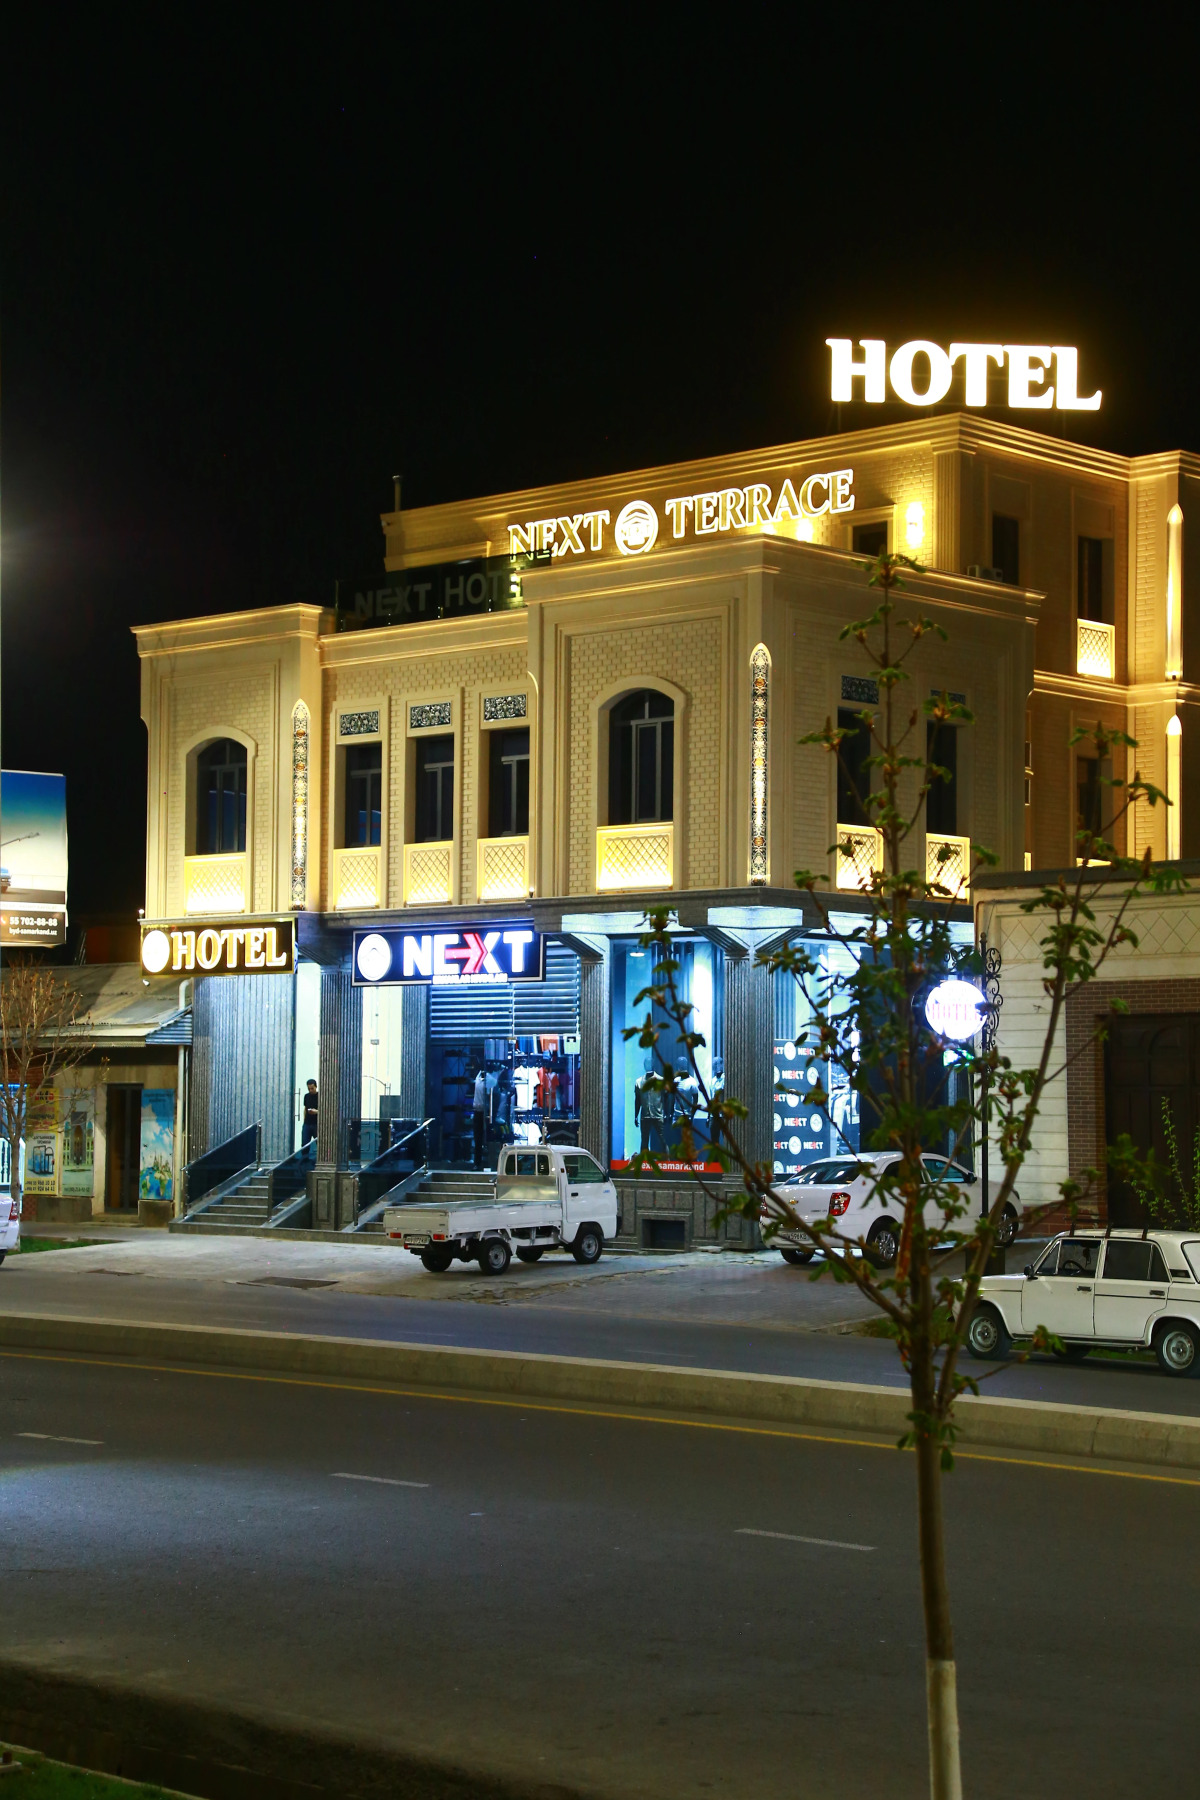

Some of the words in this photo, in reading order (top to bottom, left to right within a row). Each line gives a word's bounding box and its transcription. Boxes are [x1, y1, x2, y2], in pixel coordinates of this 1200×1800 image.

[825, 338, 1102, 410] HOTEL
[507, 510, 610, 562] NEXT
[665, 469, 855, 540] TERRACE
[354, 583, 432, 619] NEXT
[170, 927, 287, 971] HOTEL
[403, 931, 533, 977] NEXT
[781, 1070, 804, 1079] NEXT
[784, 1117, 807, 1127] NEXT
[803, 1141, 823, 1150] NEXT
